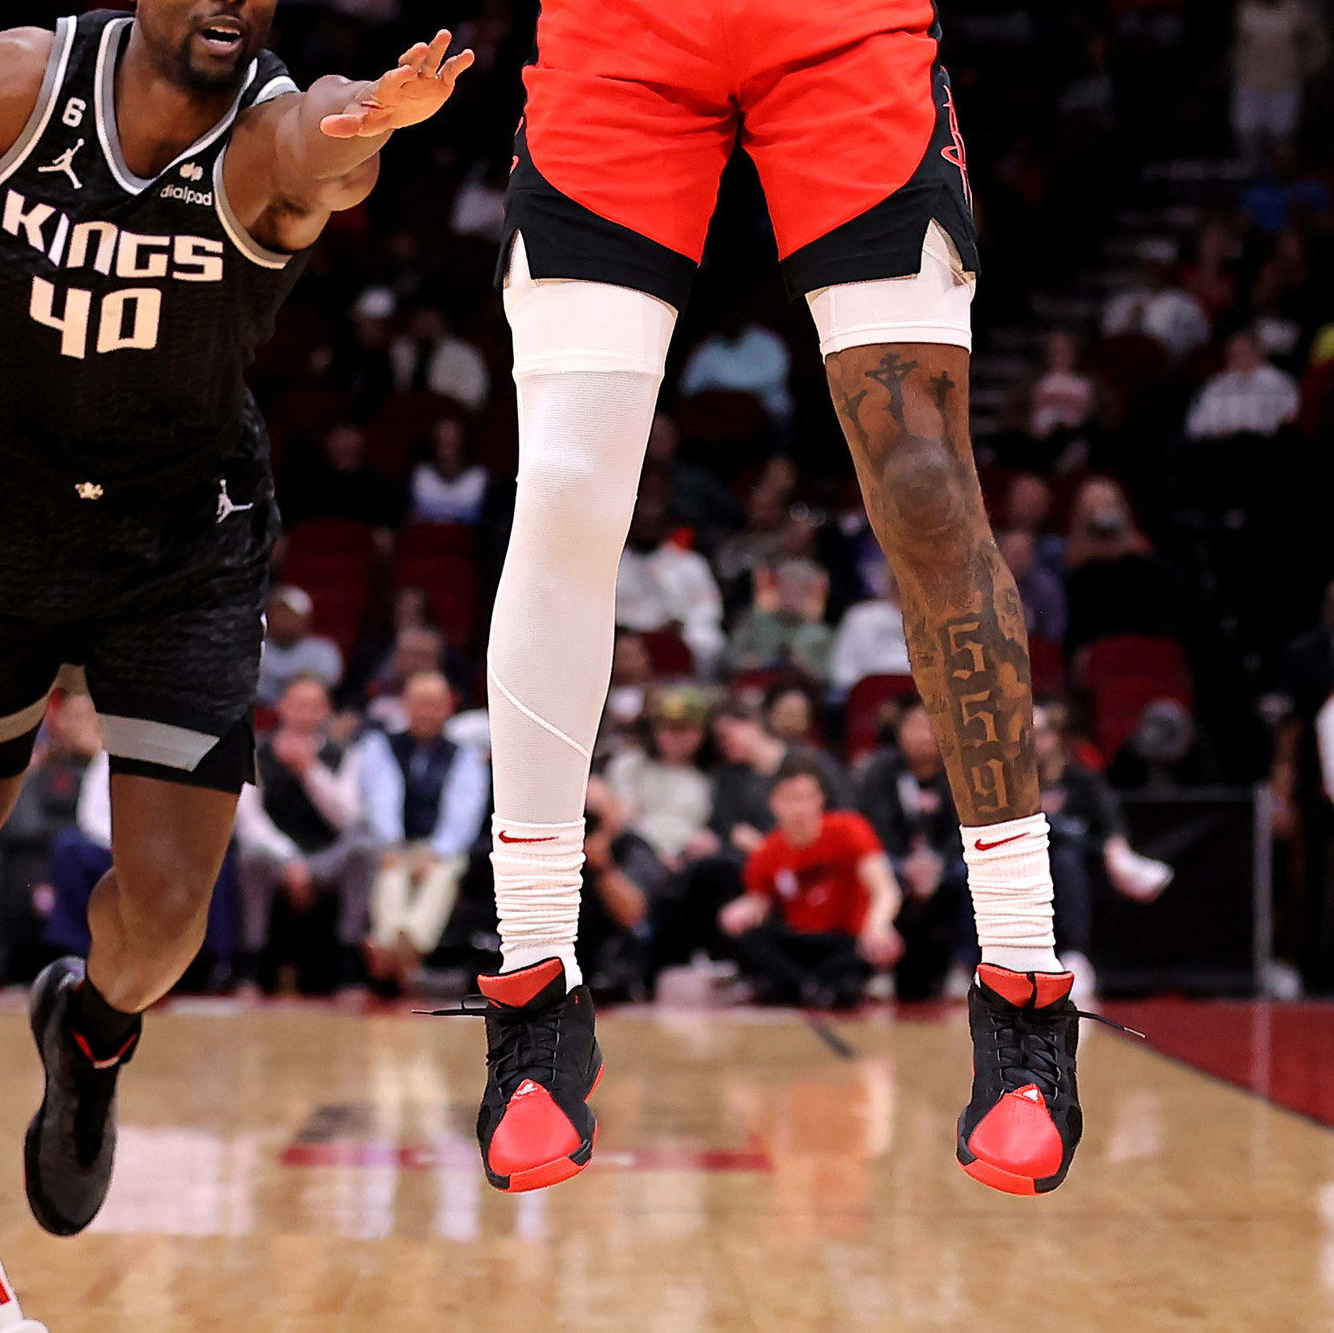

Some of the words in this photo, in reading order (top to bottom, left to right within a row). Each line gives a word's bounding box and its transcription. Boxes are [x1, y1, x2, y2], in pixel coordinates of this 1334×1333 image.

[61, 96, 87, 128] 6
[160, 183, 213, 207] dialpad
[1, 187, 224, 282] KINGS
[28, 273, 163, 360] 40
